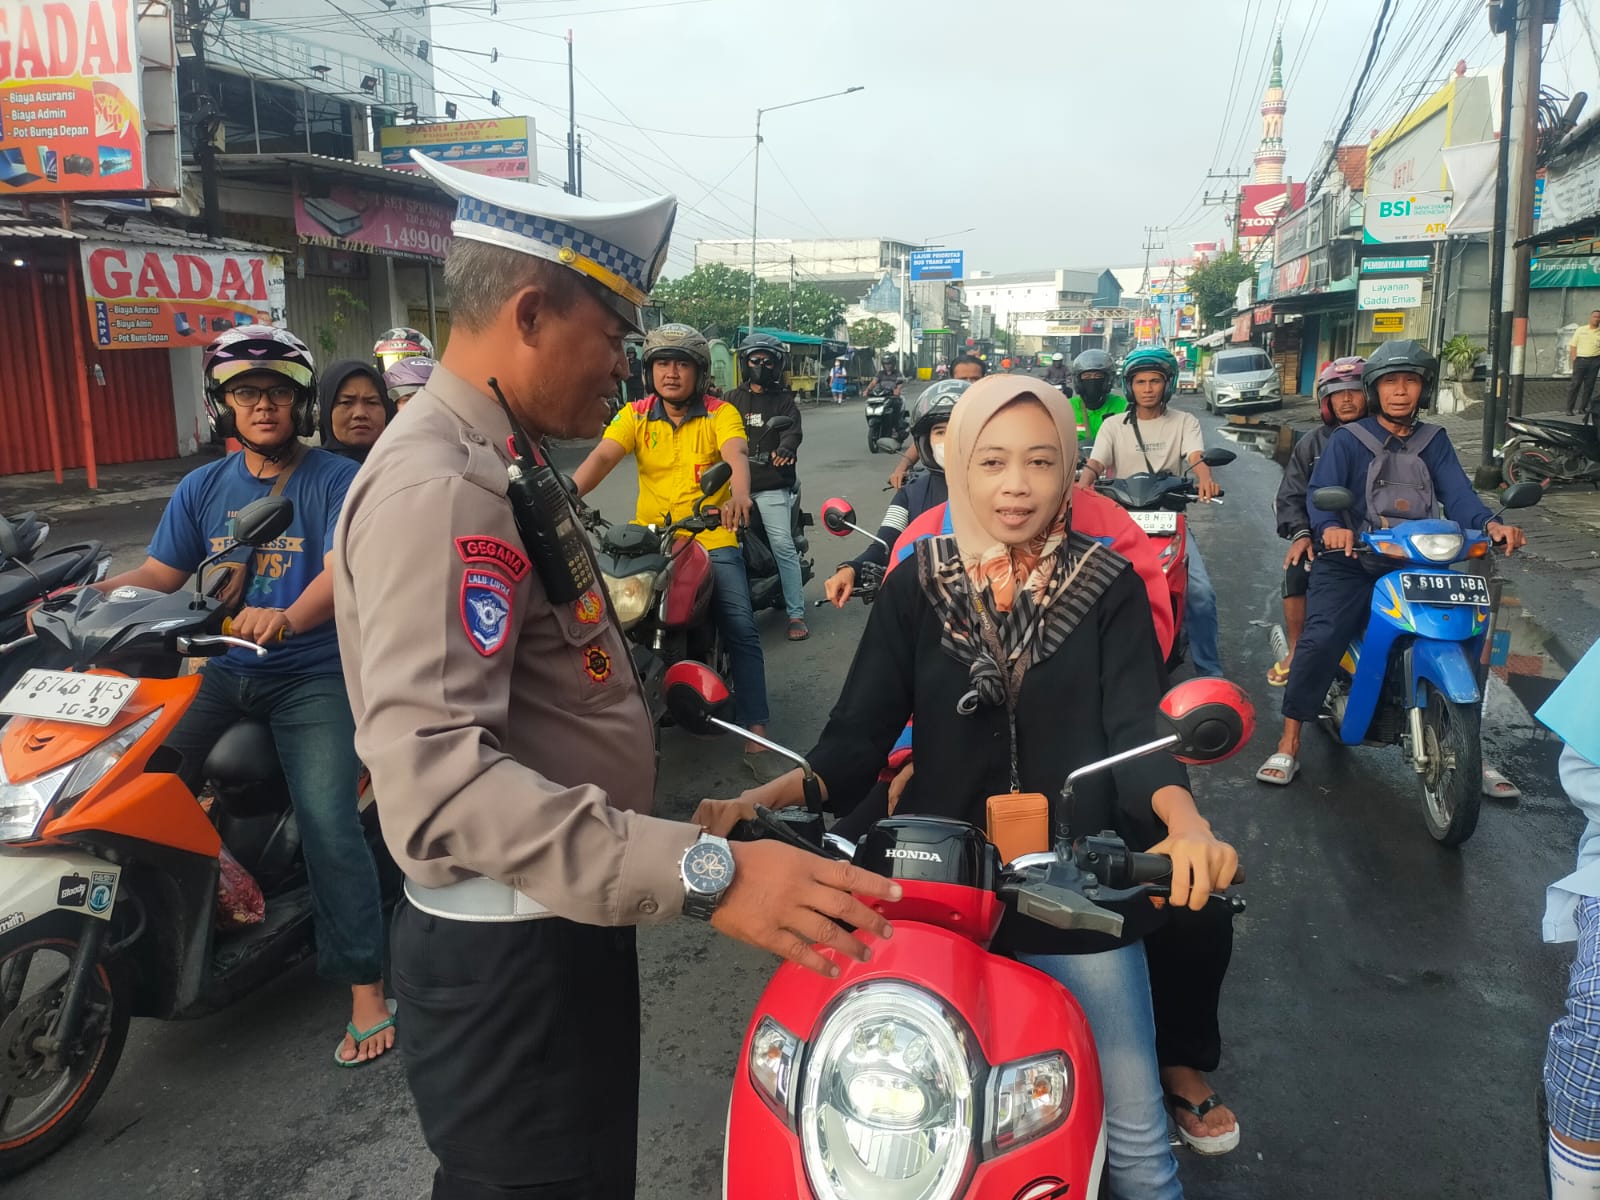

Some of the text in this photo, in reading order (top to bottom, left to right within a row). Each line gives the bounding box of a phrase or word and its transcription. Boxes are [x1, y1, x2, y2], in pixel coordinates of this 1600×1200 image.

[10, 89, 76, 104] Biaya Asuransi
[11, 108, 67, 122] Biaya Admin
[13, 125, 89, 138] Pot Bunga Depan
[405, 121, 498, 134] SAMI JAYA
[1379, 200, 1411, 217] BSI
[298, 232, 338, 245] SAMI
[89, 248, 268, 301] GADAI
[1372, 283, 1409, 293] Layanan
[1363, 295, 1416, 305] Gadai Emas
[114, 305, 133, 315] Biaya
[96, 303, 109, 344] TANPA
[116, 320, 135, 329] Biaya
[118, 334, 129, 342] Pot
[148, 333, 168, 342] Depan
[466, 541, 525, 573] GEGANA
[468, 574, 511, 596] LALU LINTAS
[885, 849, 943, 862] HONDA
